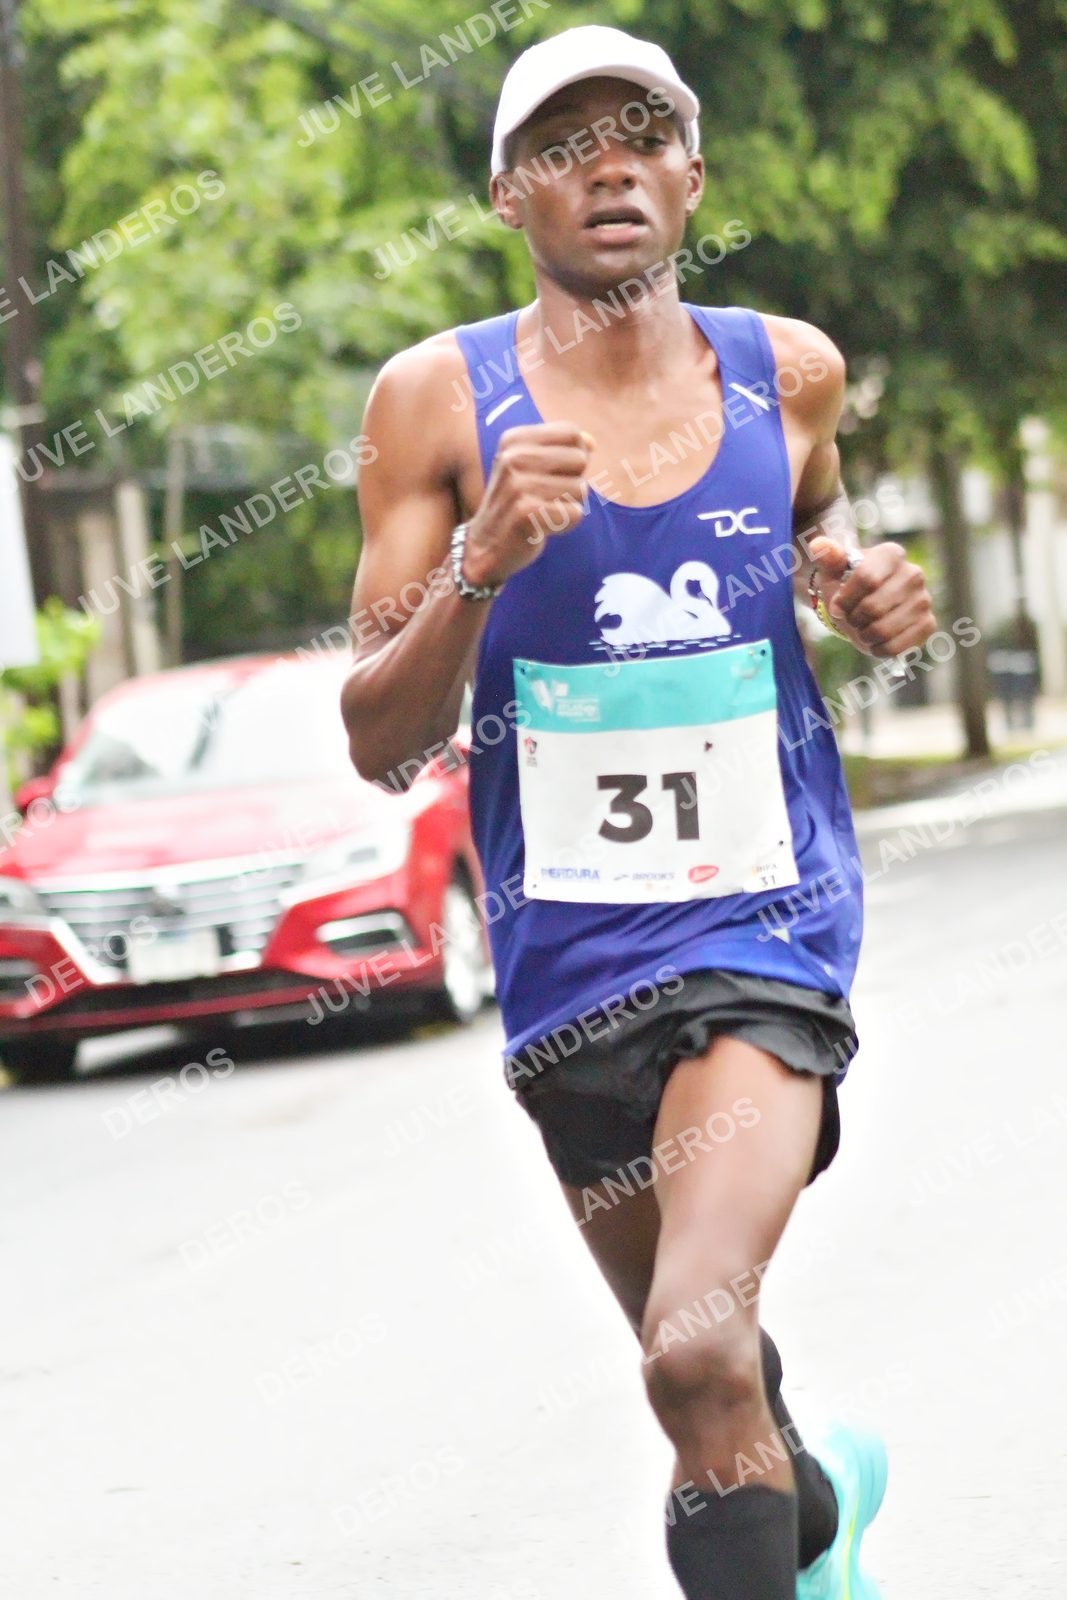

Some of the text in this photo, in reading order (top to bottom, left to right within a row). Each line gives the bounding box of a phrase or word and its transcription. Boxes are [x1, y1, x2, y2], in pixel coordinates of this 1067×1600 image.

[697, 507, 771, 537] DC
[597, 771, 700, 843] 31
[760, 875, 776, 888] 31
